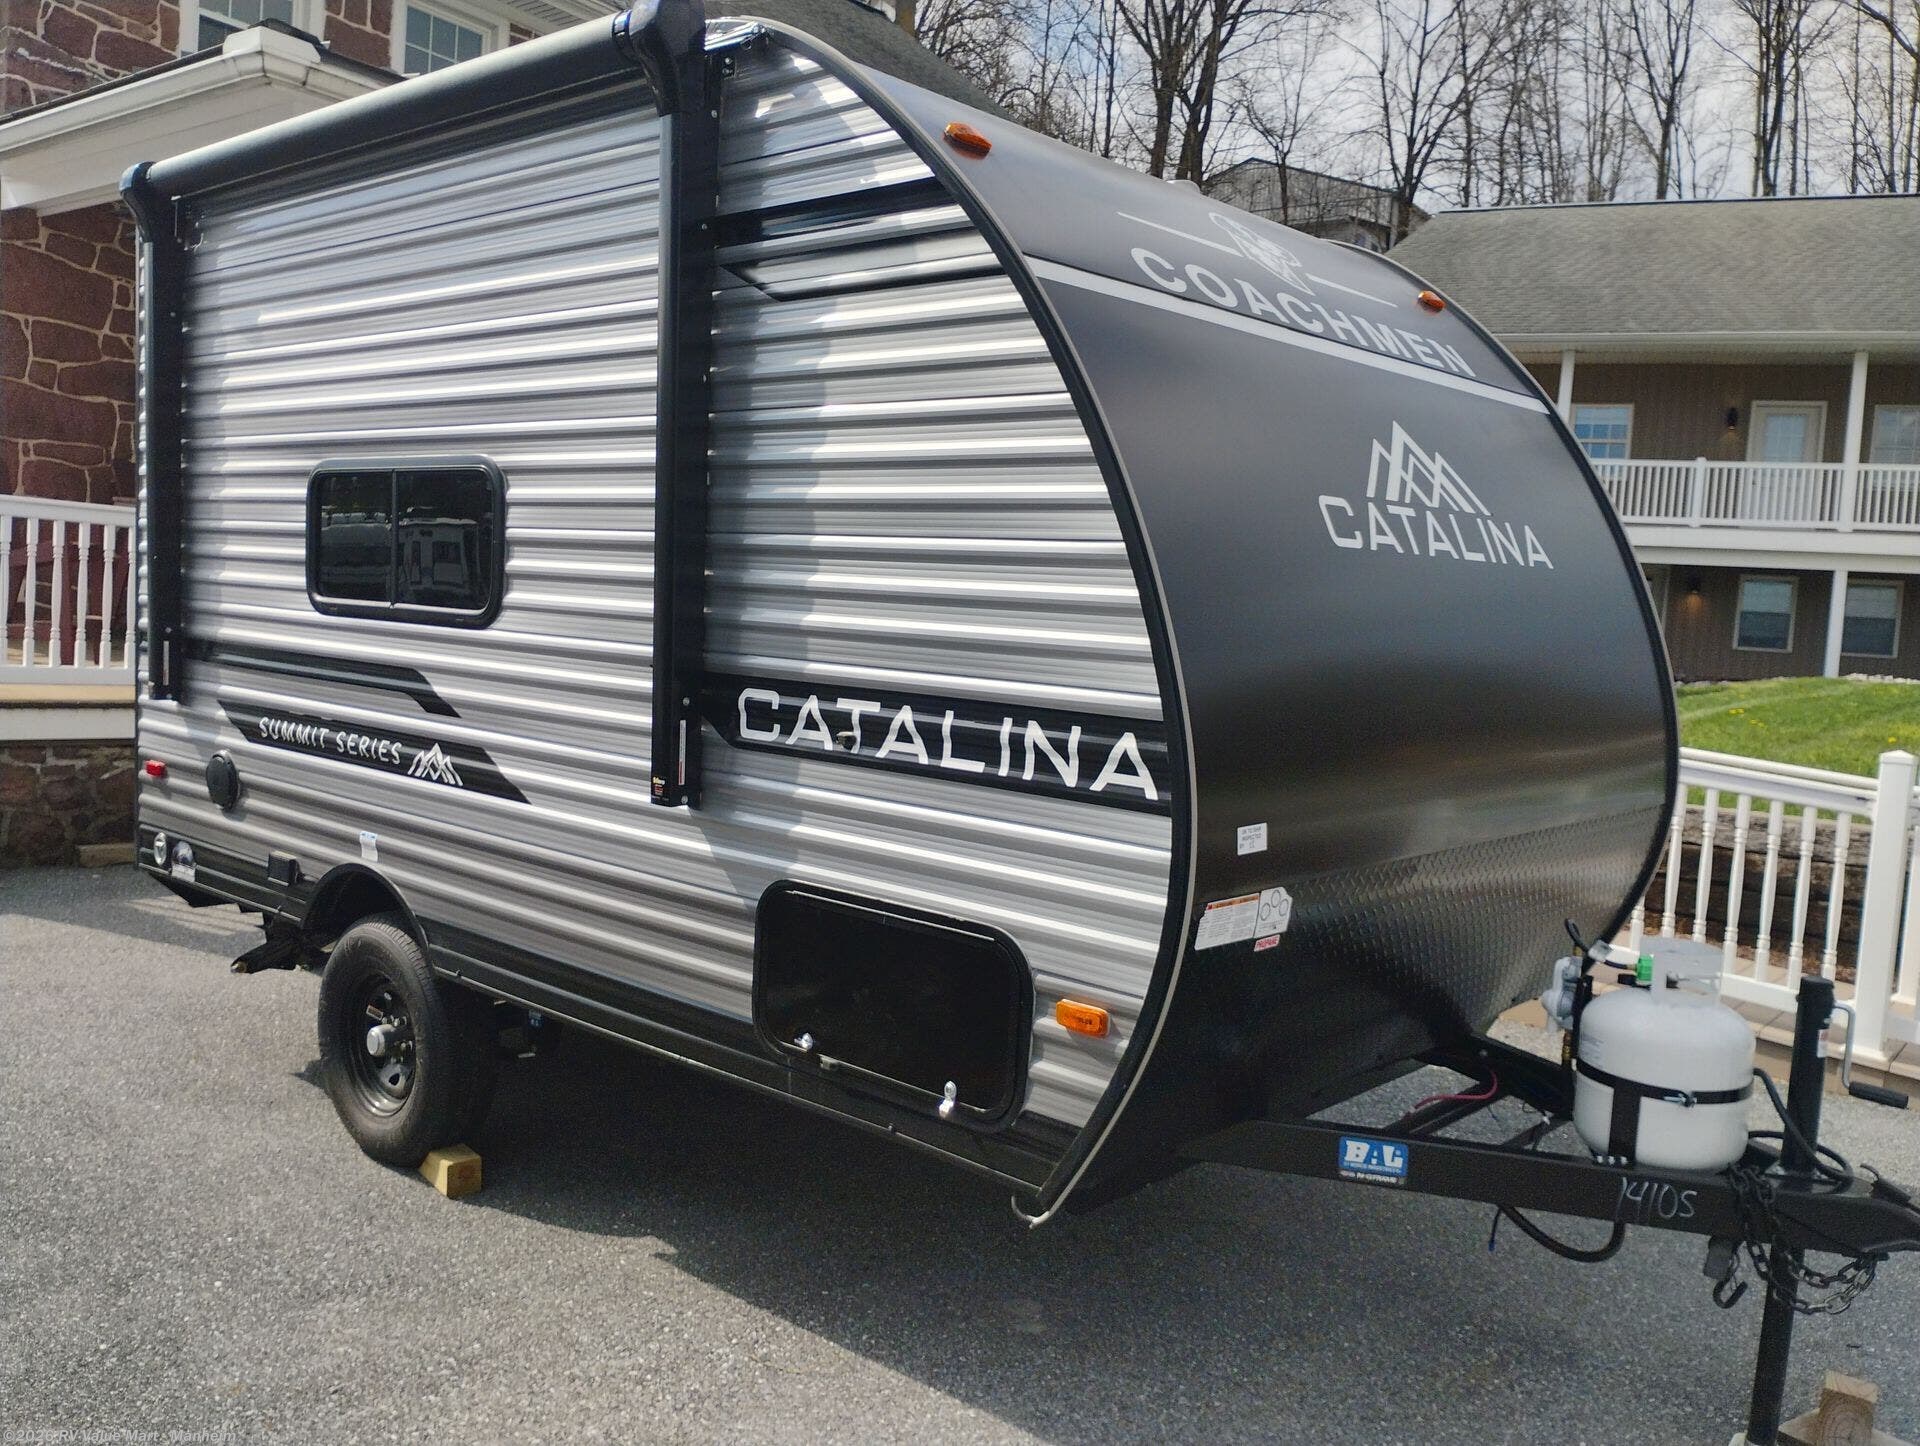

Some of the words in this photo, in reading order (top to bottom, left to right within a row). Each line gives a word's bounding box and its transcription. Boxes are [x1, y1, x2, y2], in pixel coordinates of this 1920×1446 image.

[1130, 247, 1476, 377] COACHMEN
[1318, 494, 1554, 570] CATALINA
[259, 716, 329, 749] SUMMIT
[335, 731, 402, 765] SERIES
[737, 687, 1159, 801] CATALINA
[1344, 1140, 1403, 1168] BAL
